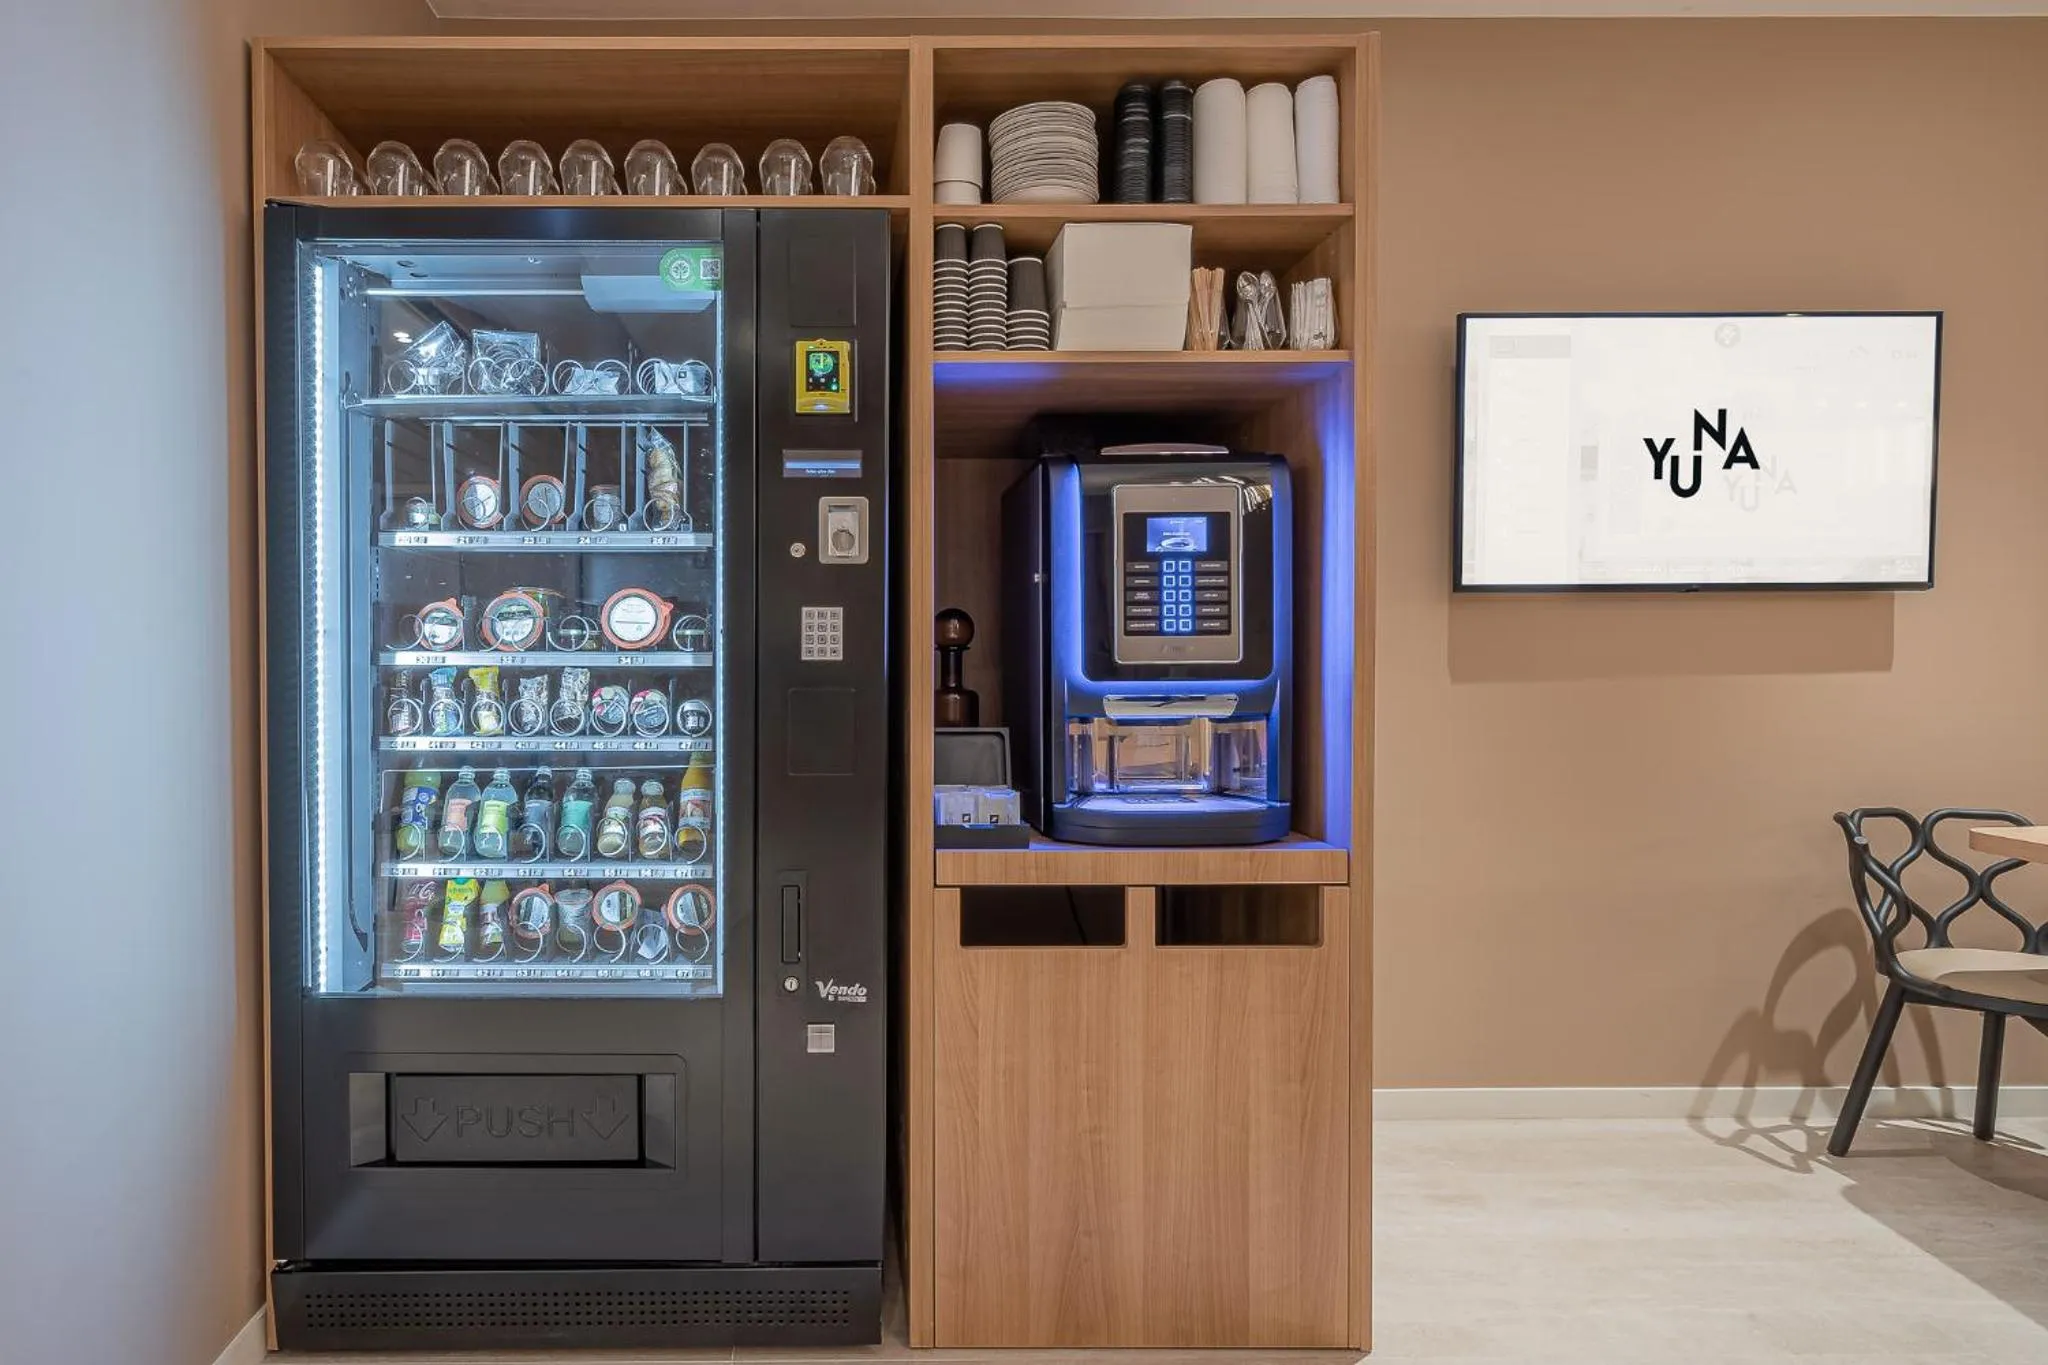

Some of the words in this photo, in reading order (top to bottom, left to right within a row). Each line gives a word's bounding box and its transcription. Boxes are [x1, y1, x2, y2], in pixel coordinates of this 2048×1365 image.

[1643, 408, 1761, 499] YUNA
[815, 977, 868, 998] Vendo
[455, 1105, 576, 1138] PUSH
